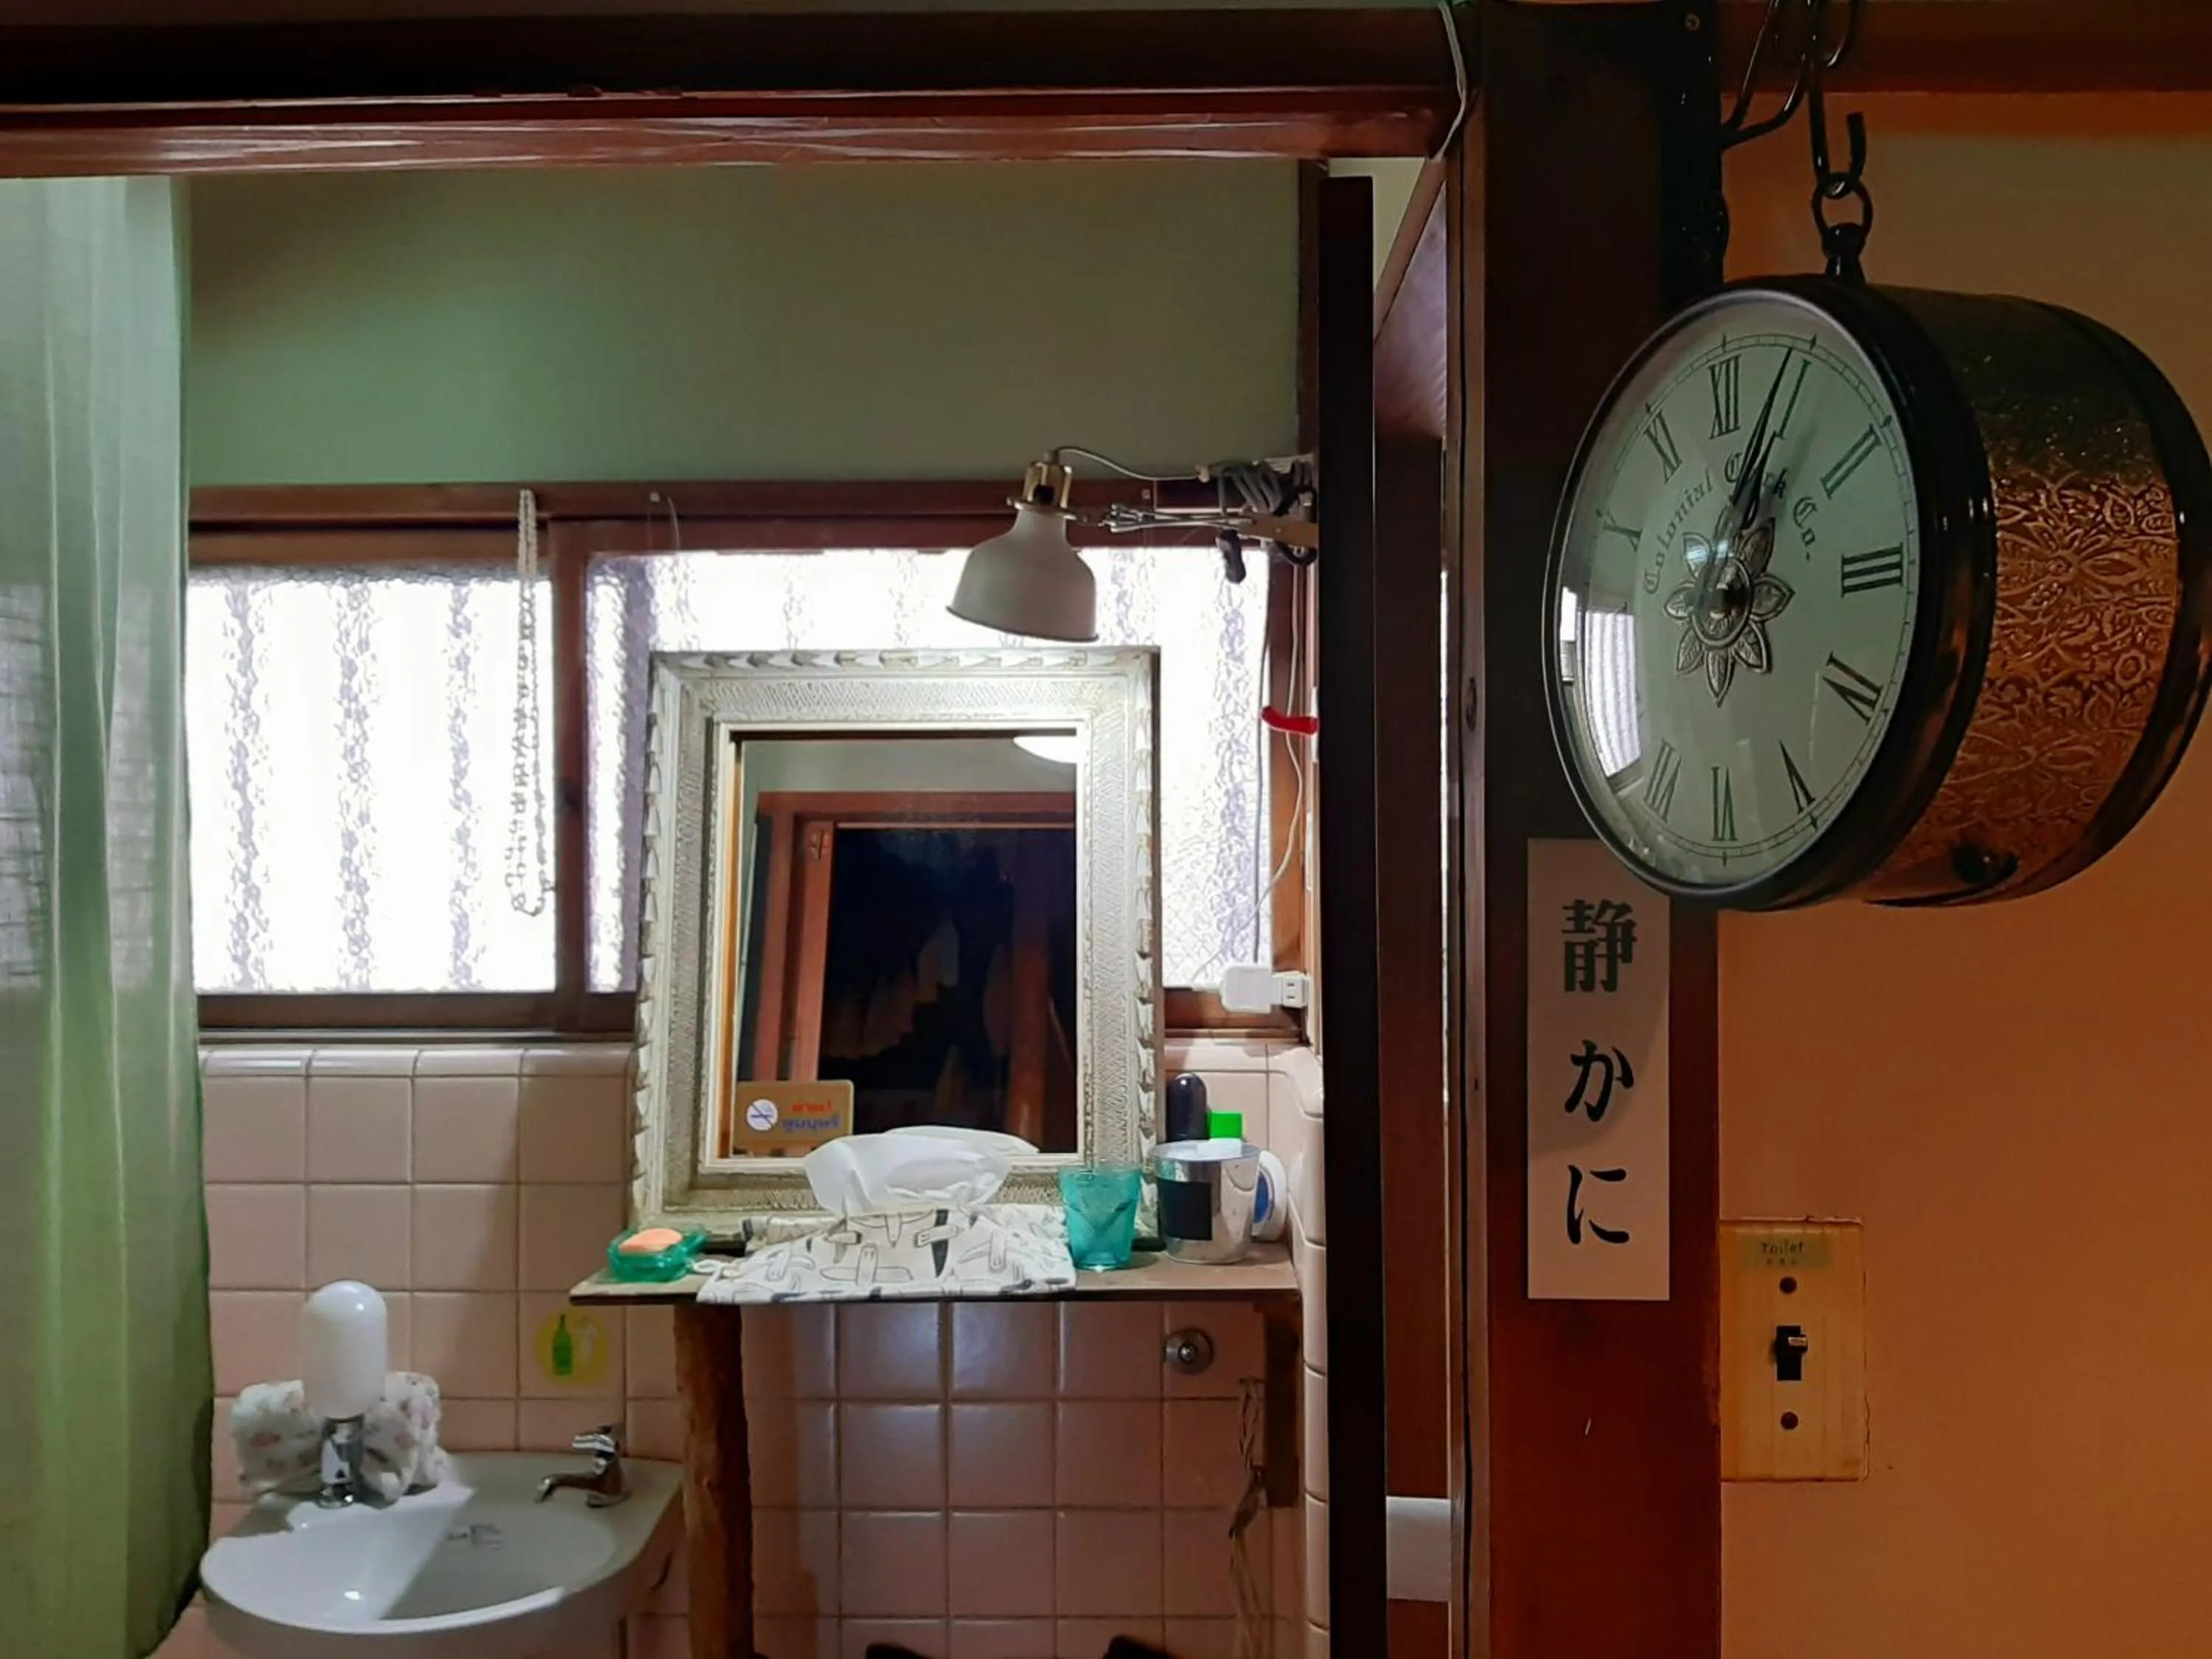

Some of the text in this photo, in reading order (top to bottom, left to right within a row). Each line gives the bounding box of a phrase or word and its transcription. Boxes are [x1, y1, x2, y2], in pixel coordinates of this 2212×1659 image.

[1708, 354, 1742, 439] XII
[1643, 408, 1683, 484] XI
[1820, 422, 1882, 500] II
[1841, 542, 1903, 598] III
[1778, 740, 1815, 814] V
[1561, 899, 1638, 1246] 静かに
